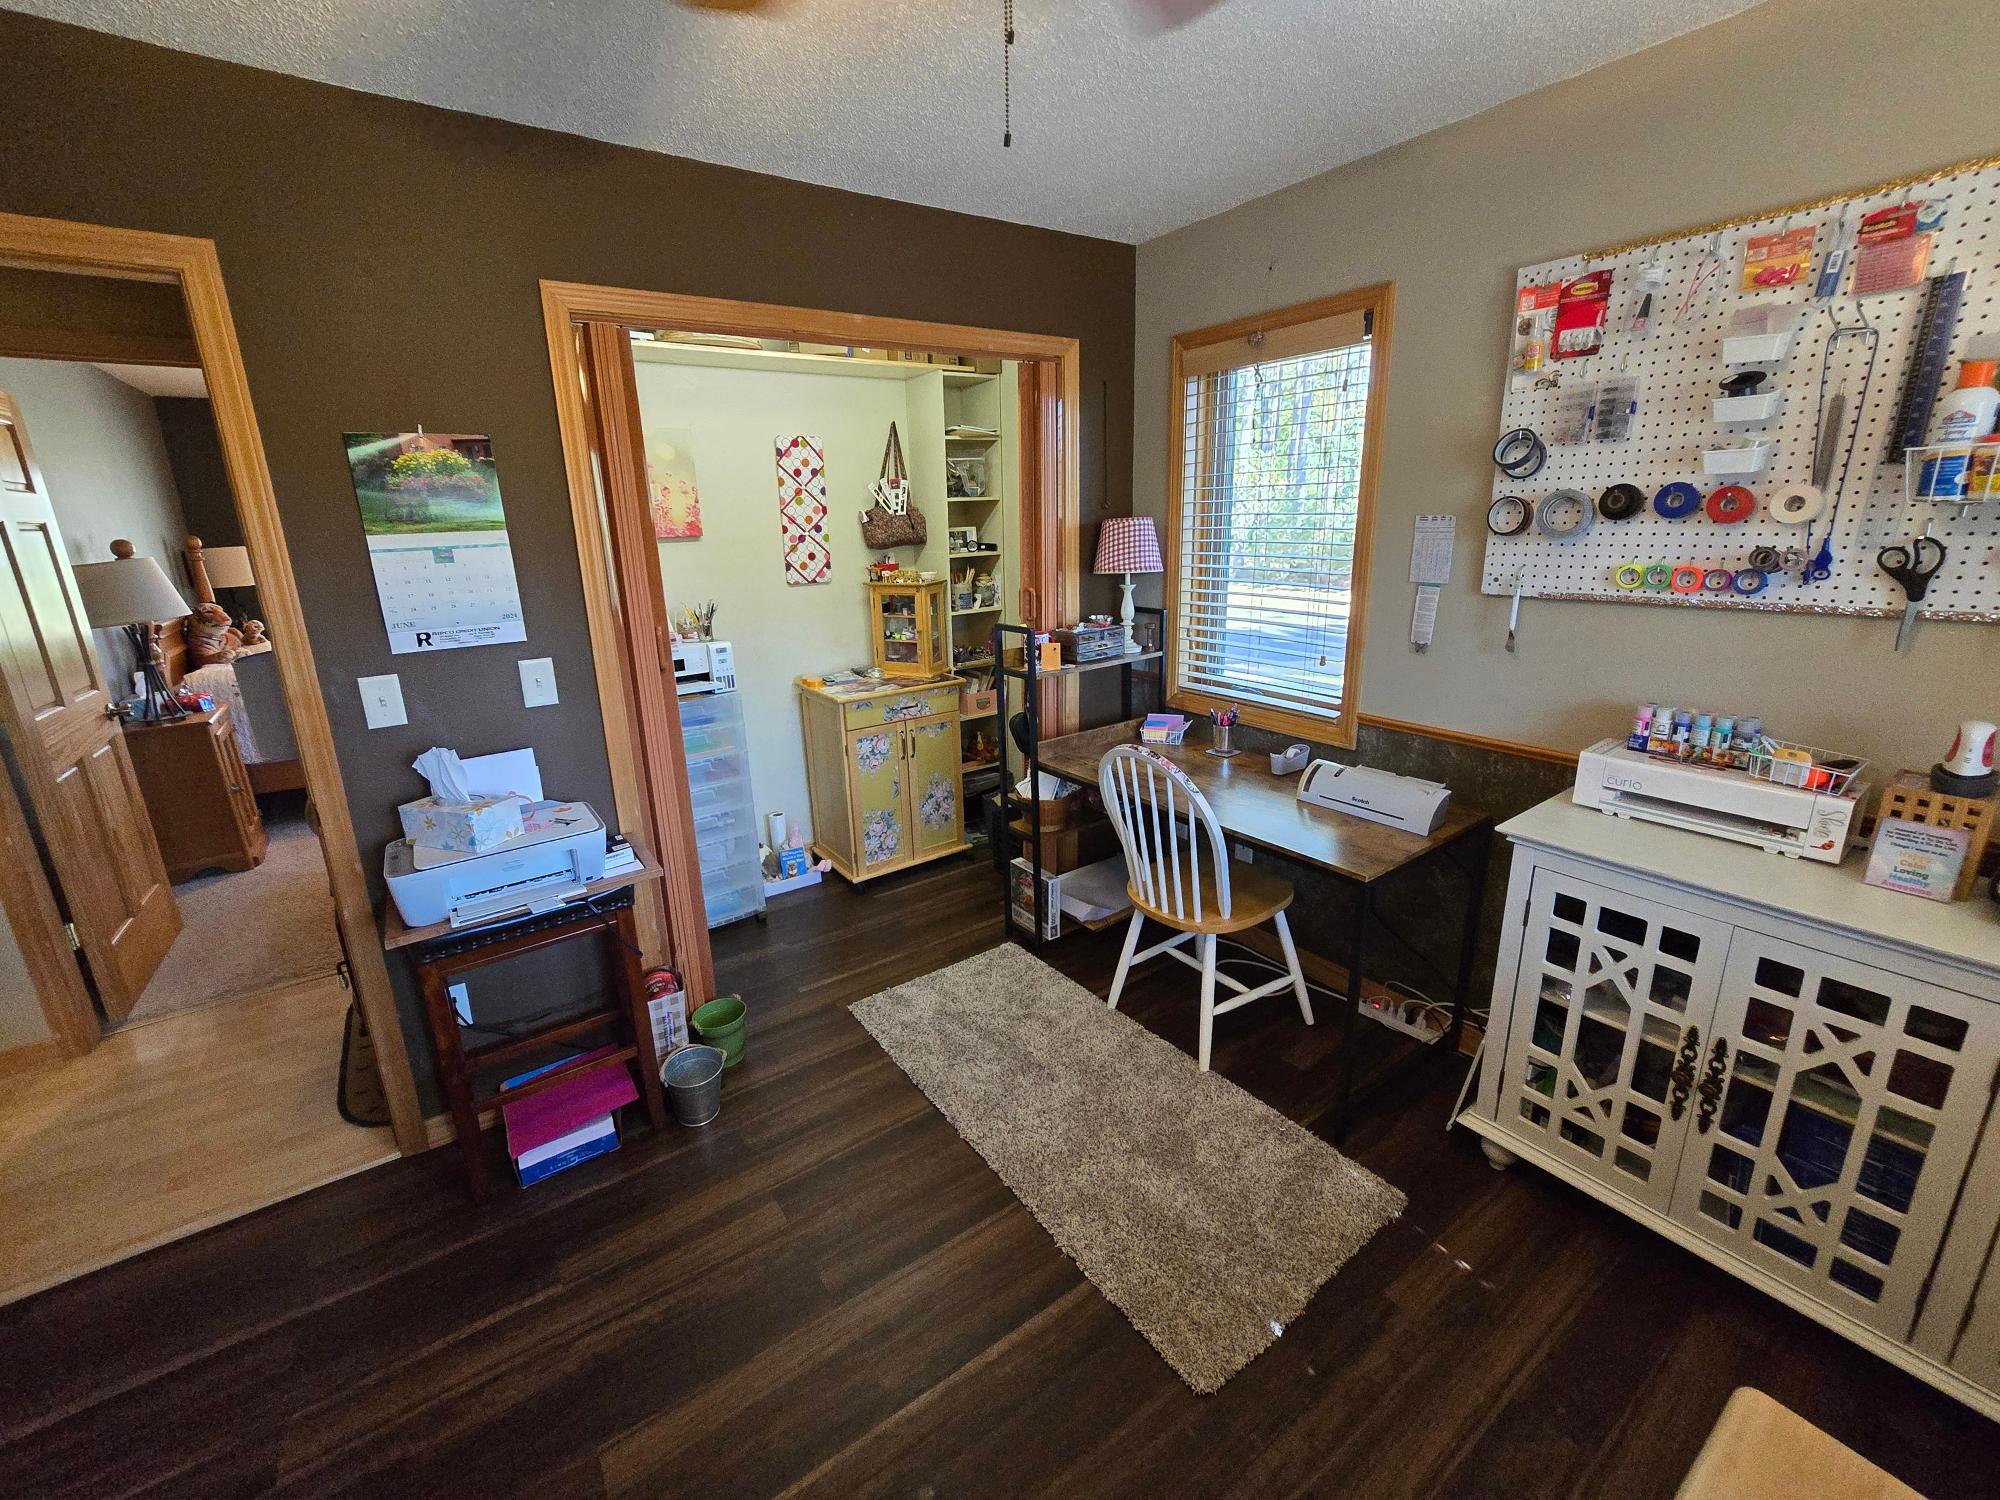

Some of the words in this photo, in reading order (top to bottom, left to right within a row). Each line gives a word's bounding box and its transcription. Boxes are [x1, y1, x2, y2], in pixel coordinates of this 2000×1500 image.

[391, 622, 416, 630] JUNE
[1606, 776, 1642, 790] curio
[1888, 872, 1930, 888] Healthy
[1894, 866, 1929, 880] Loving
[1881, 880, 1932, 896] Awesome
